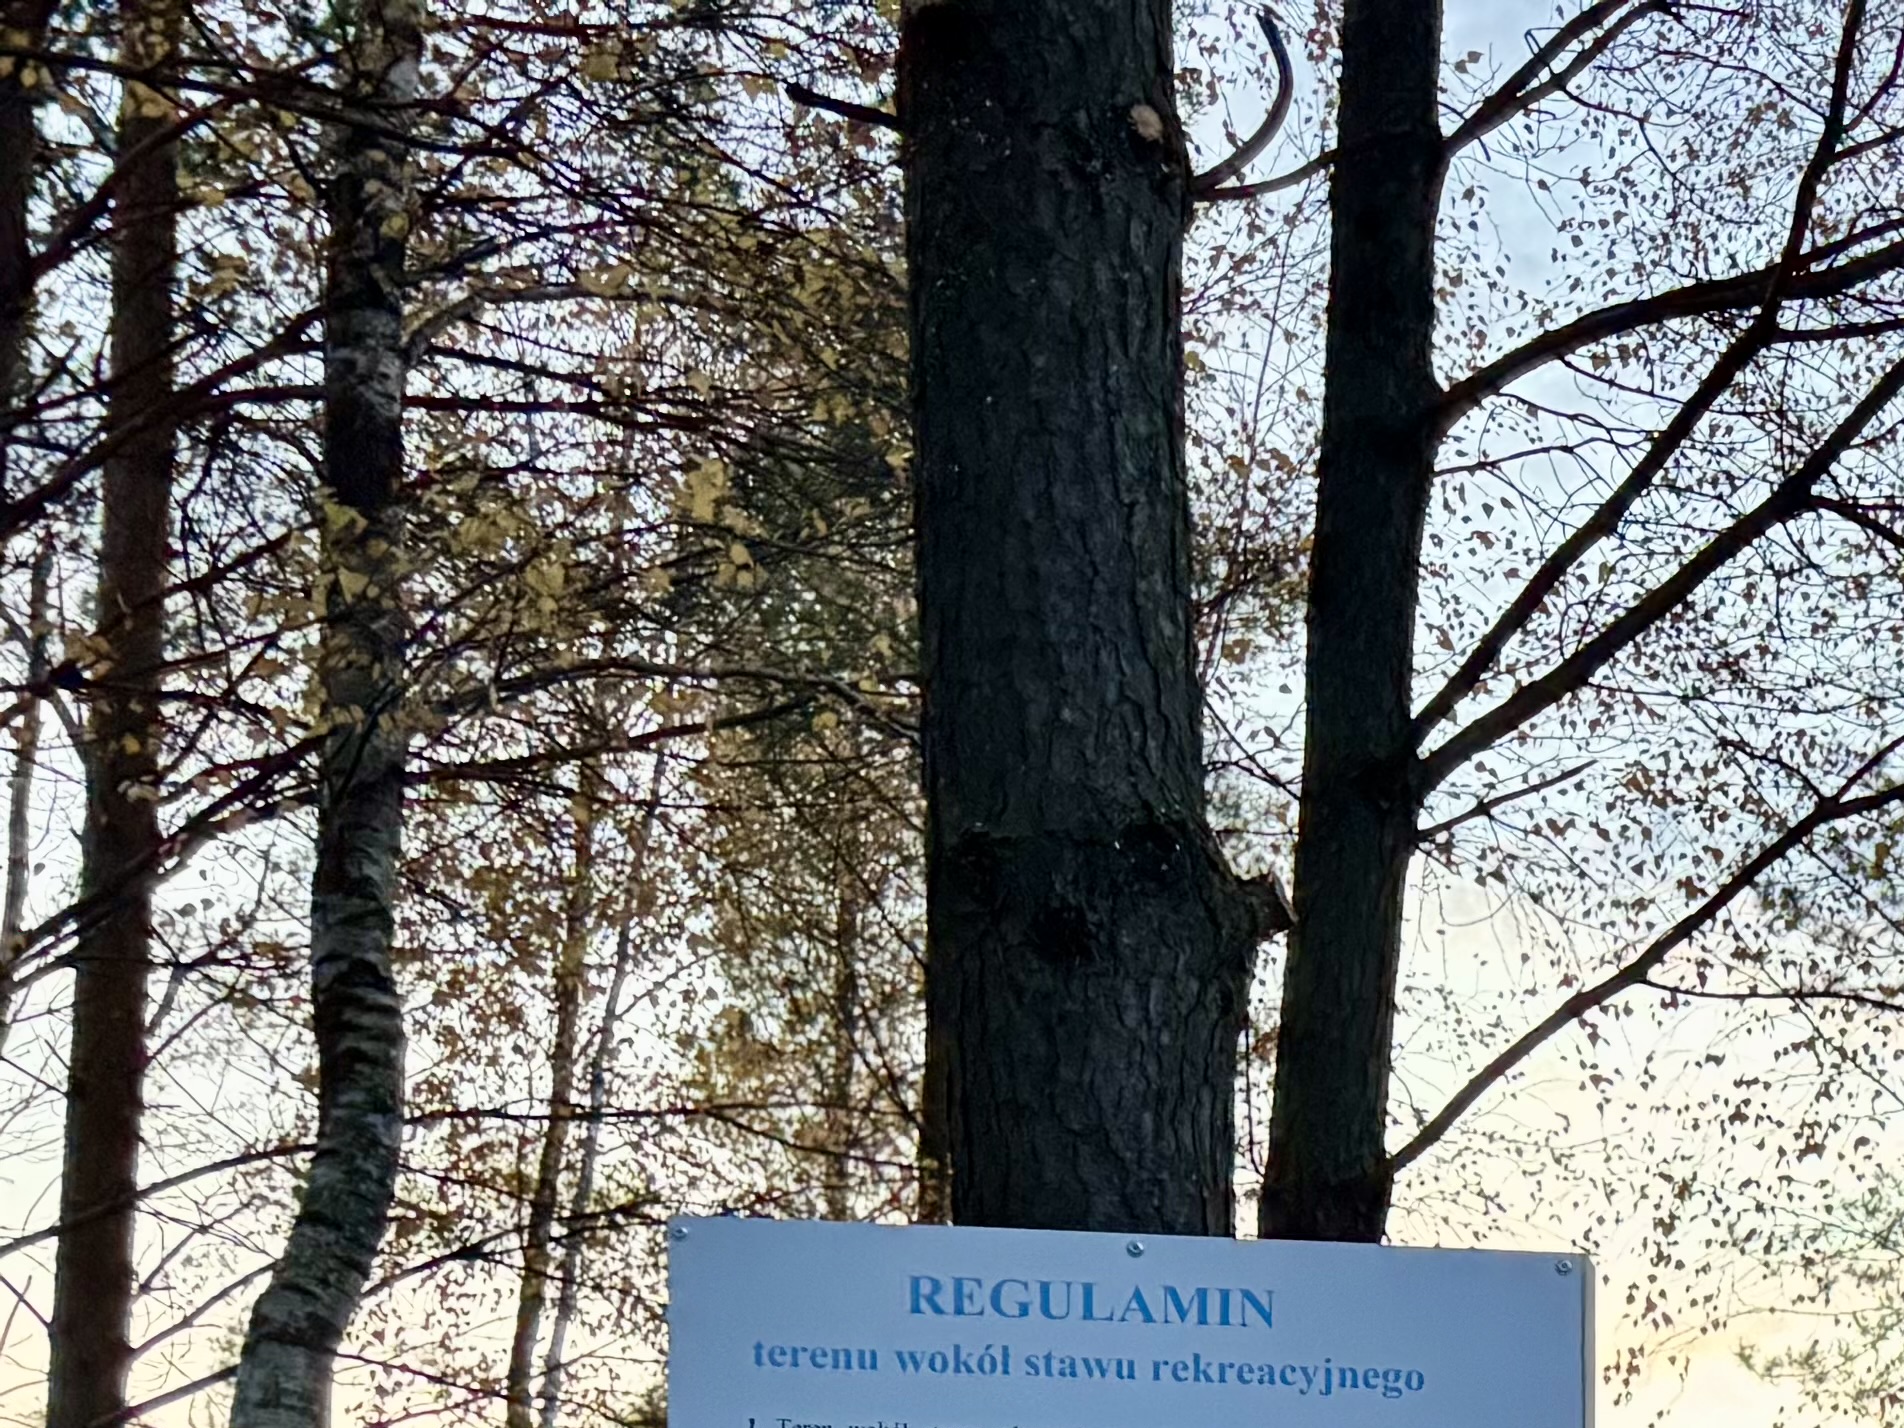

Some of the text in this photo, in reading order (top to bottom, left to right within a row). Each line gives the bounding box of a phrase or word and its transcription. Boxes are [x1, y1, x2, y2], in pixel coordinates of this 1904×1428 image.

[909, 1274, 1275, 1330] REGULAMIN
[752, 1340, 1425, 1400] terenu wokół stawu rekreacyjnego
